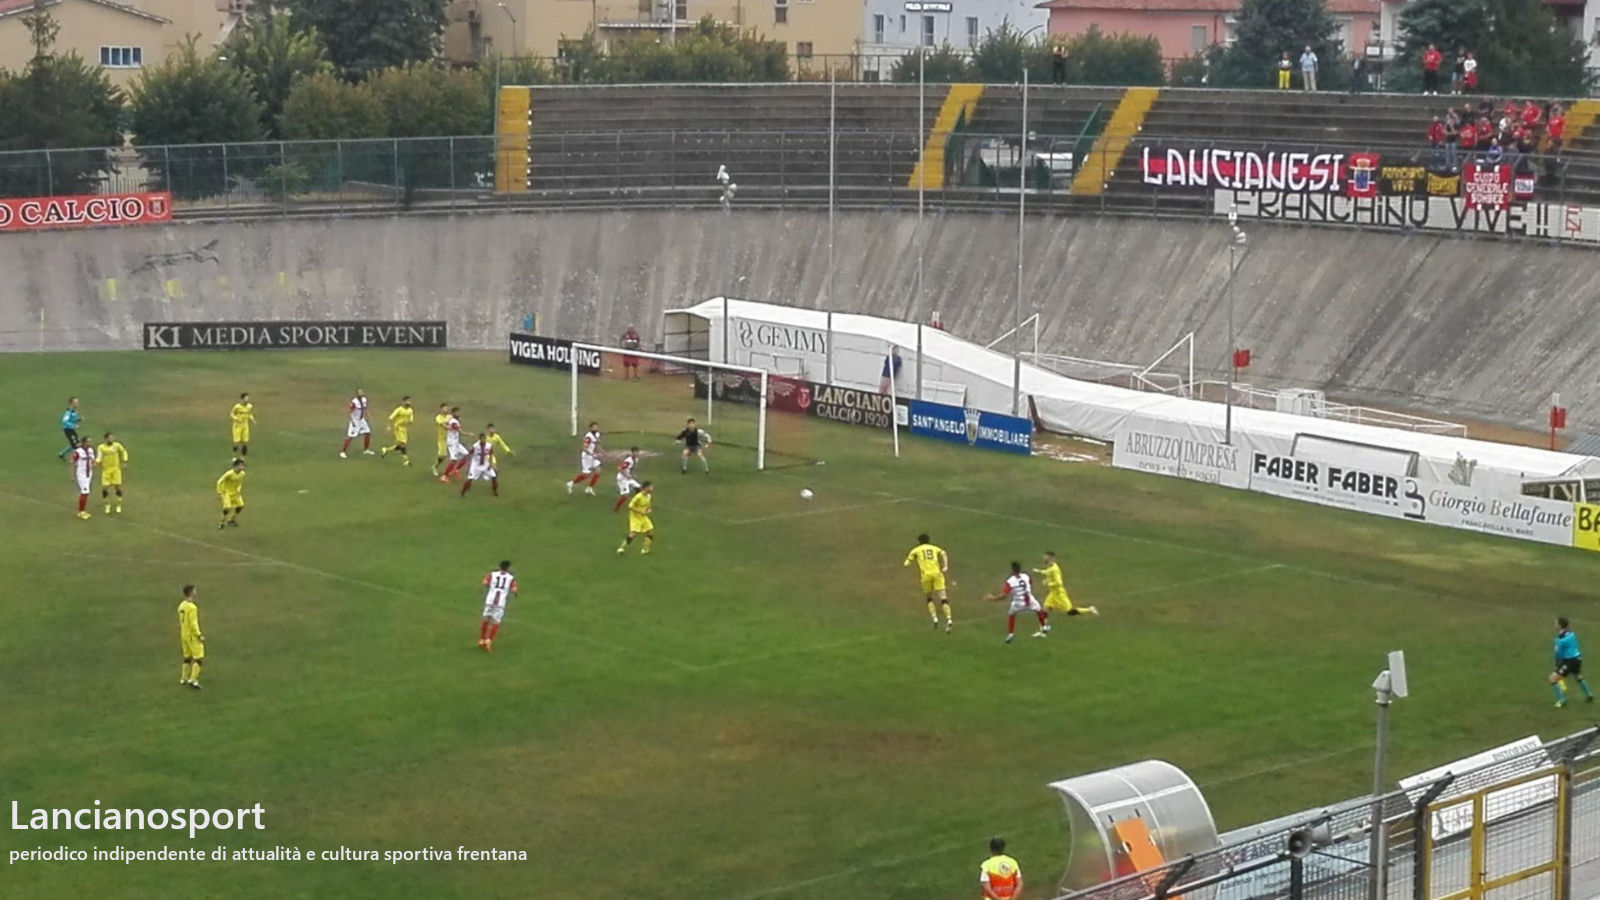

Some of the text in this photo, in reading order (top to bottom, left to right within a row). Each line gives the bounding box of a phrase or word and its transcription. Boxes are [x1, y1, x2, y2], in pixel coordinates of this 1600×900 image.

[1143, 147, 1344, 192] LANCIANESI
[20, 198, 144, 225] CALCIO
[148, 325, 443, 347] K1 MEDIA SPORT EVENT
[758, 324, 826, 354] GEMMY
[511, 340, 600, 368] VIGEA HOLING
[814, 385, 892, 414] LANCIANO
[817, 403, 862, 422] CALCIO
[864, 412, 889, 428] 1920
[979, 426, 1030, 448] IMMOBILIARE
[1126, 431, 1239, 472] ABRUZZO IMPRESA
[1254, 452, 1319, 485] FABER
[1328, 467, 1398, 499] FABER
[1430, 489, 1486, 517] Giorgio
[1490, 499, 1572, 528] Bellafante
[495, 576, 507, 589] 11
